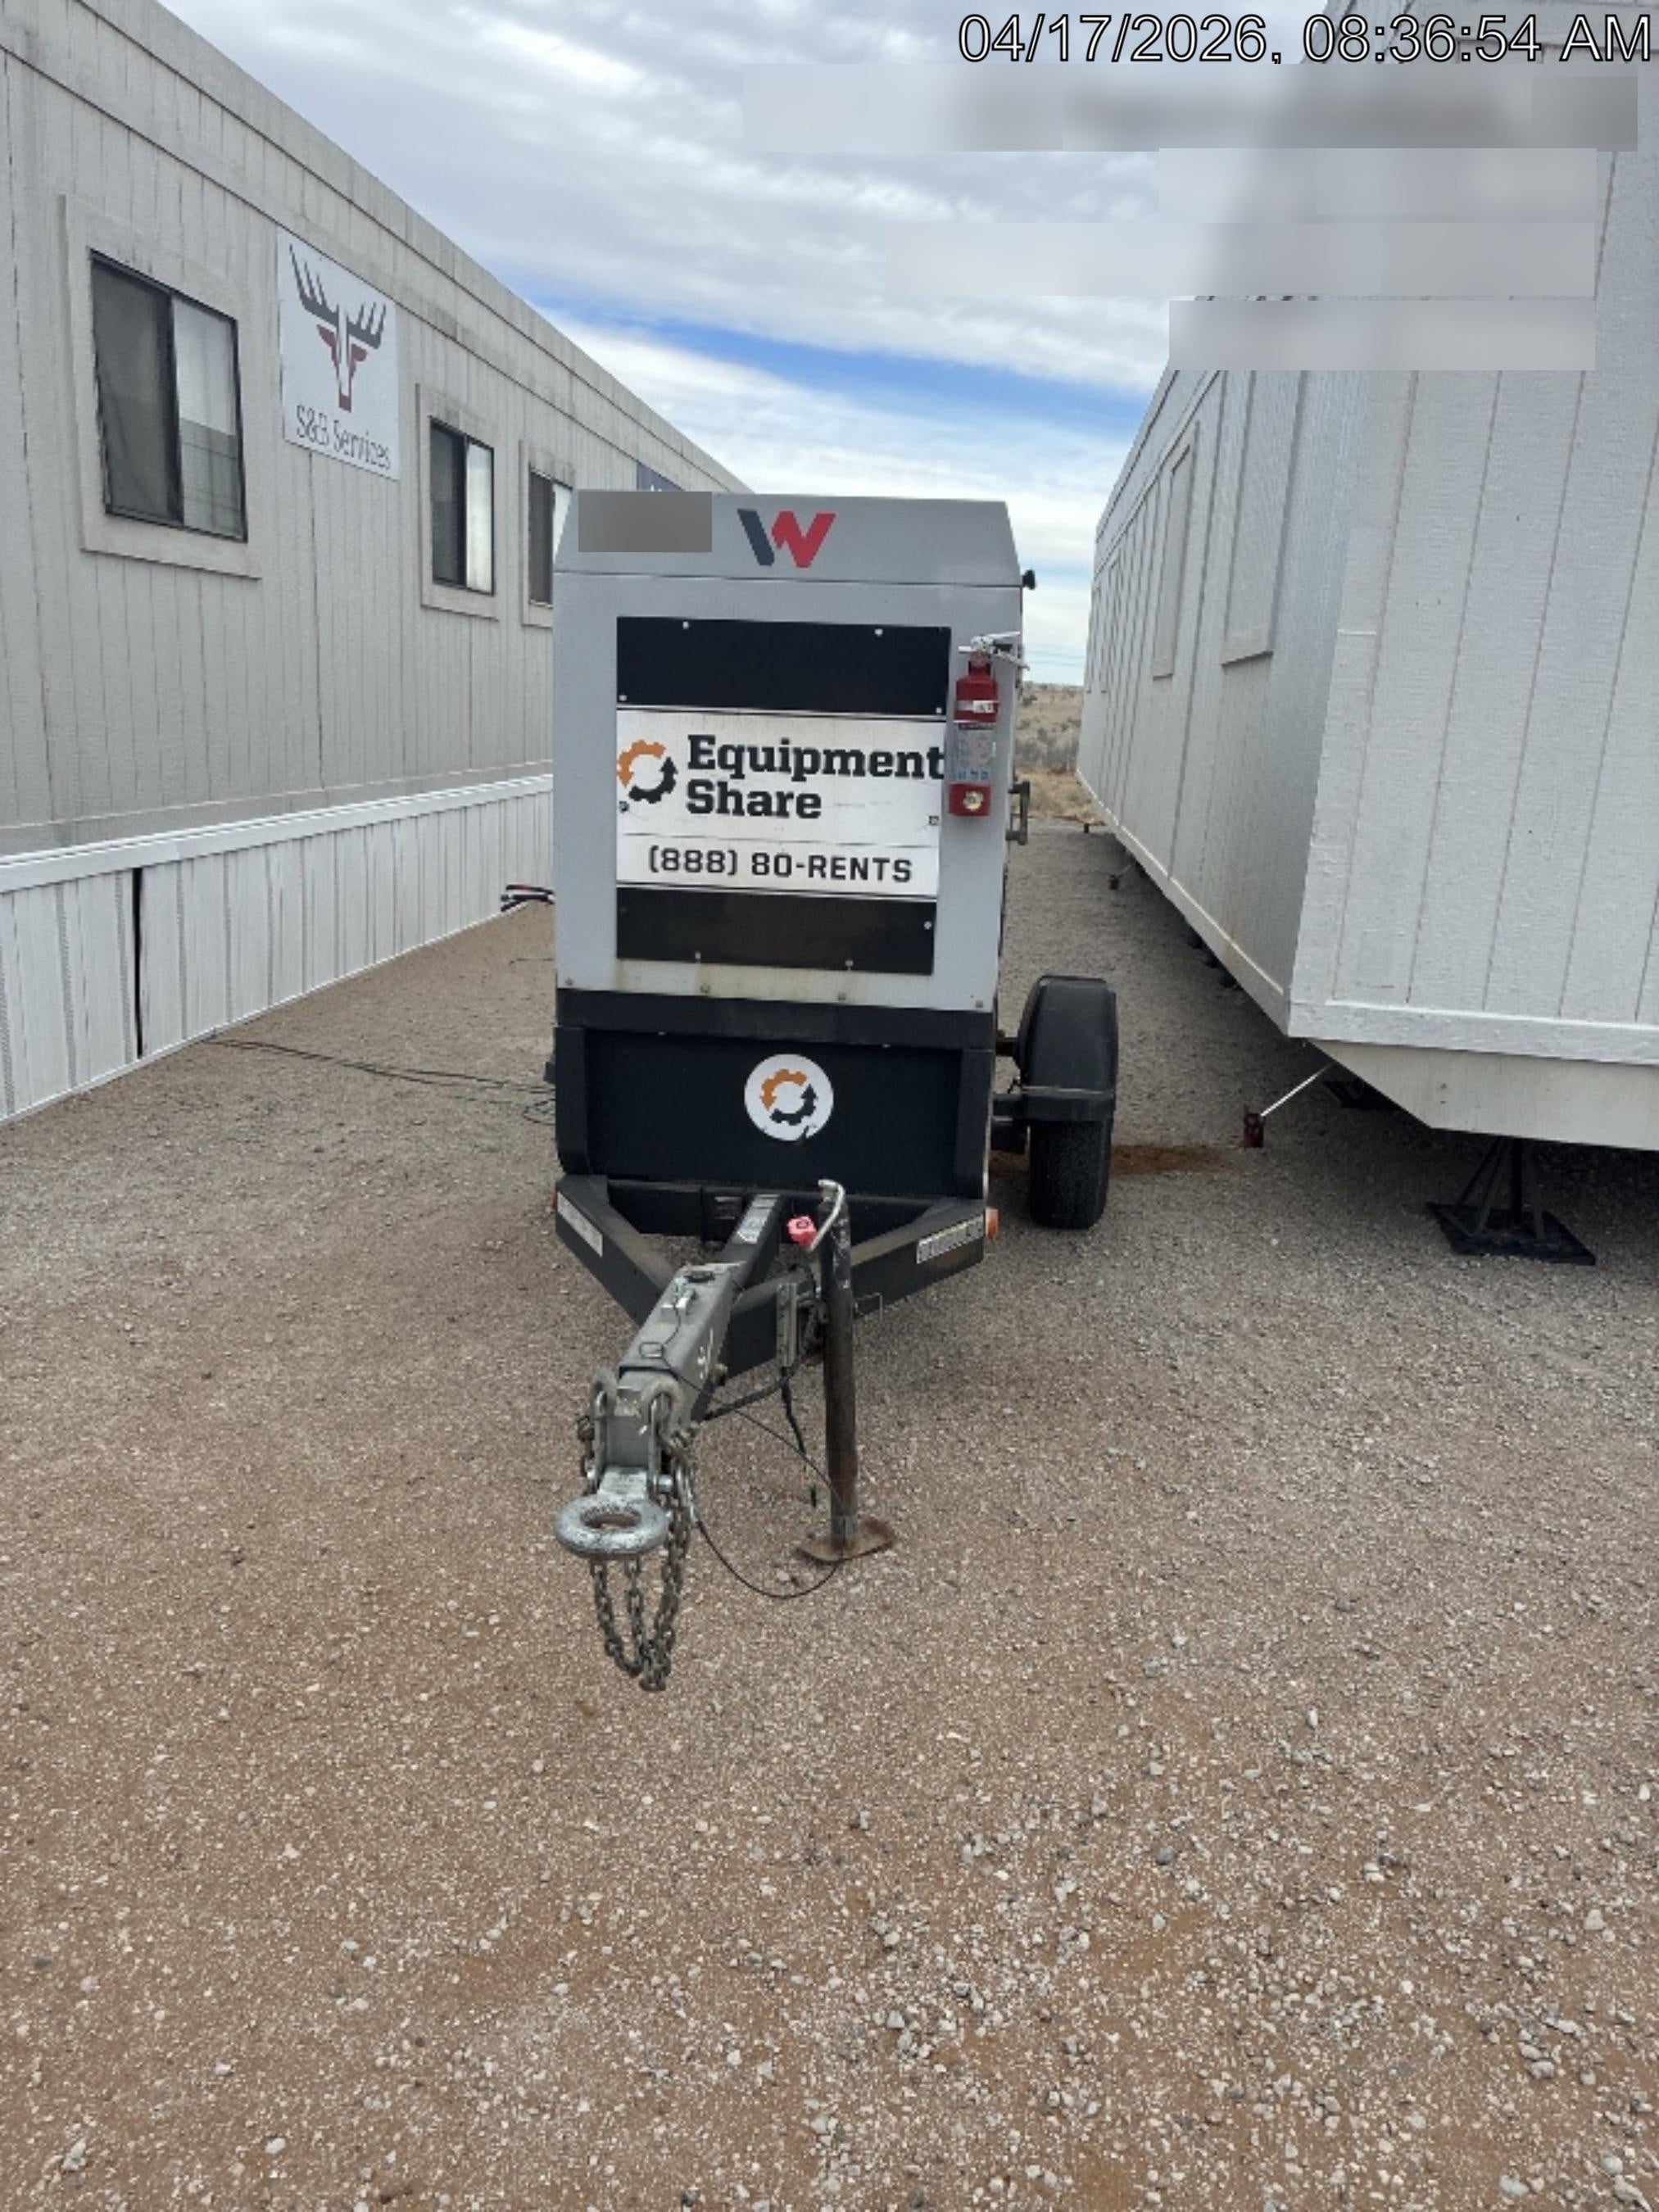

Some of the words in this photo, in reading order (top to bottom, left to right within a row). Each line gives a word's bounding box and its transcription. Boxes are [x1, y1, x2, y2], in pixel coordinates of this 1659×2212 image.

[333, 419, 390, 470] Services
[687, 734, 945, 782] Equipment
[687, 778, 822, 819] Share
[648, 845, 737, 876] (888)
[751, 852, 913, 883] 80-RENTS
